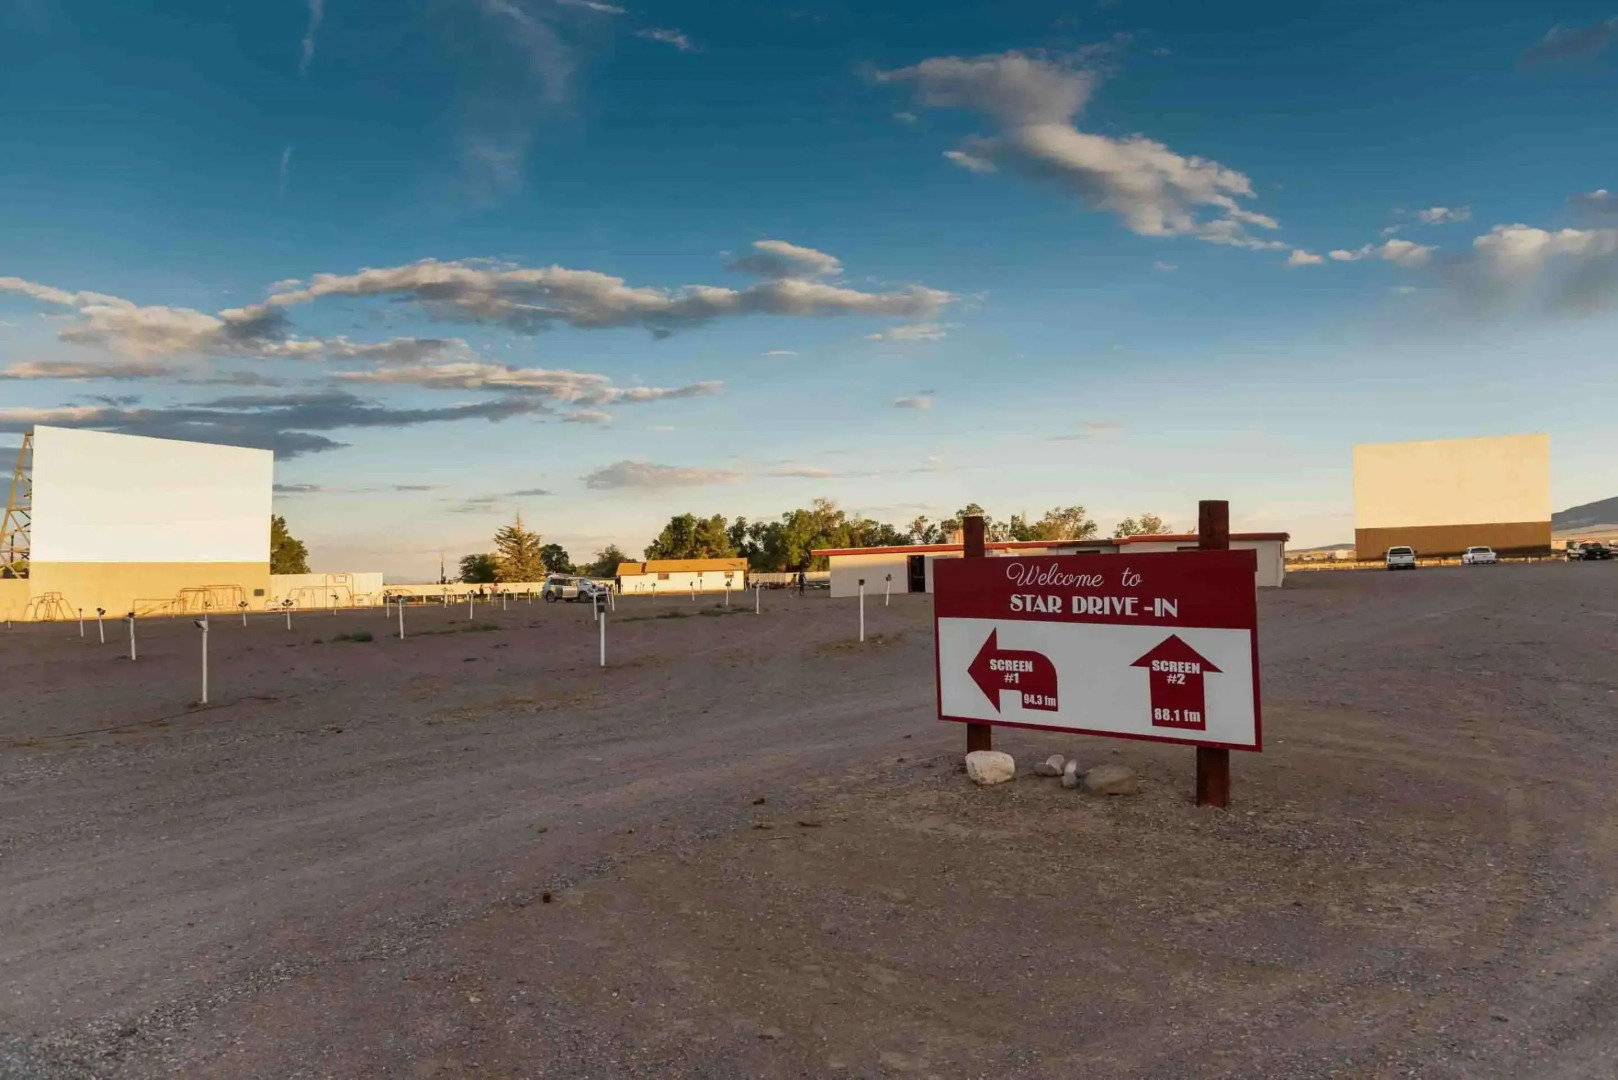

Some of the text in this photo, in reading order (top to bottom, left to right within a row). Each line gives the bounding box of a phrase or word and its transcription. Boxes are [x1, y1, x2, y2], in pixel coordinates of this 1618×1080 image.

[1006, 562, 1143, 587] Welcome to
[1010, 594, 1062, 614] STAR
[1072, 595, 1139, 616] DRIVE
[989, 659, 1033, 673] SCREEN
[1151, 659, 1201, 674] SCREEN
[1004, 672, 1020, 684] #1
[1166, 673, 1186, 686] #2
[1023, 694, 1057, 707] 94.3 fm
[1154, 708, 1201, 723] 88.1 fm
